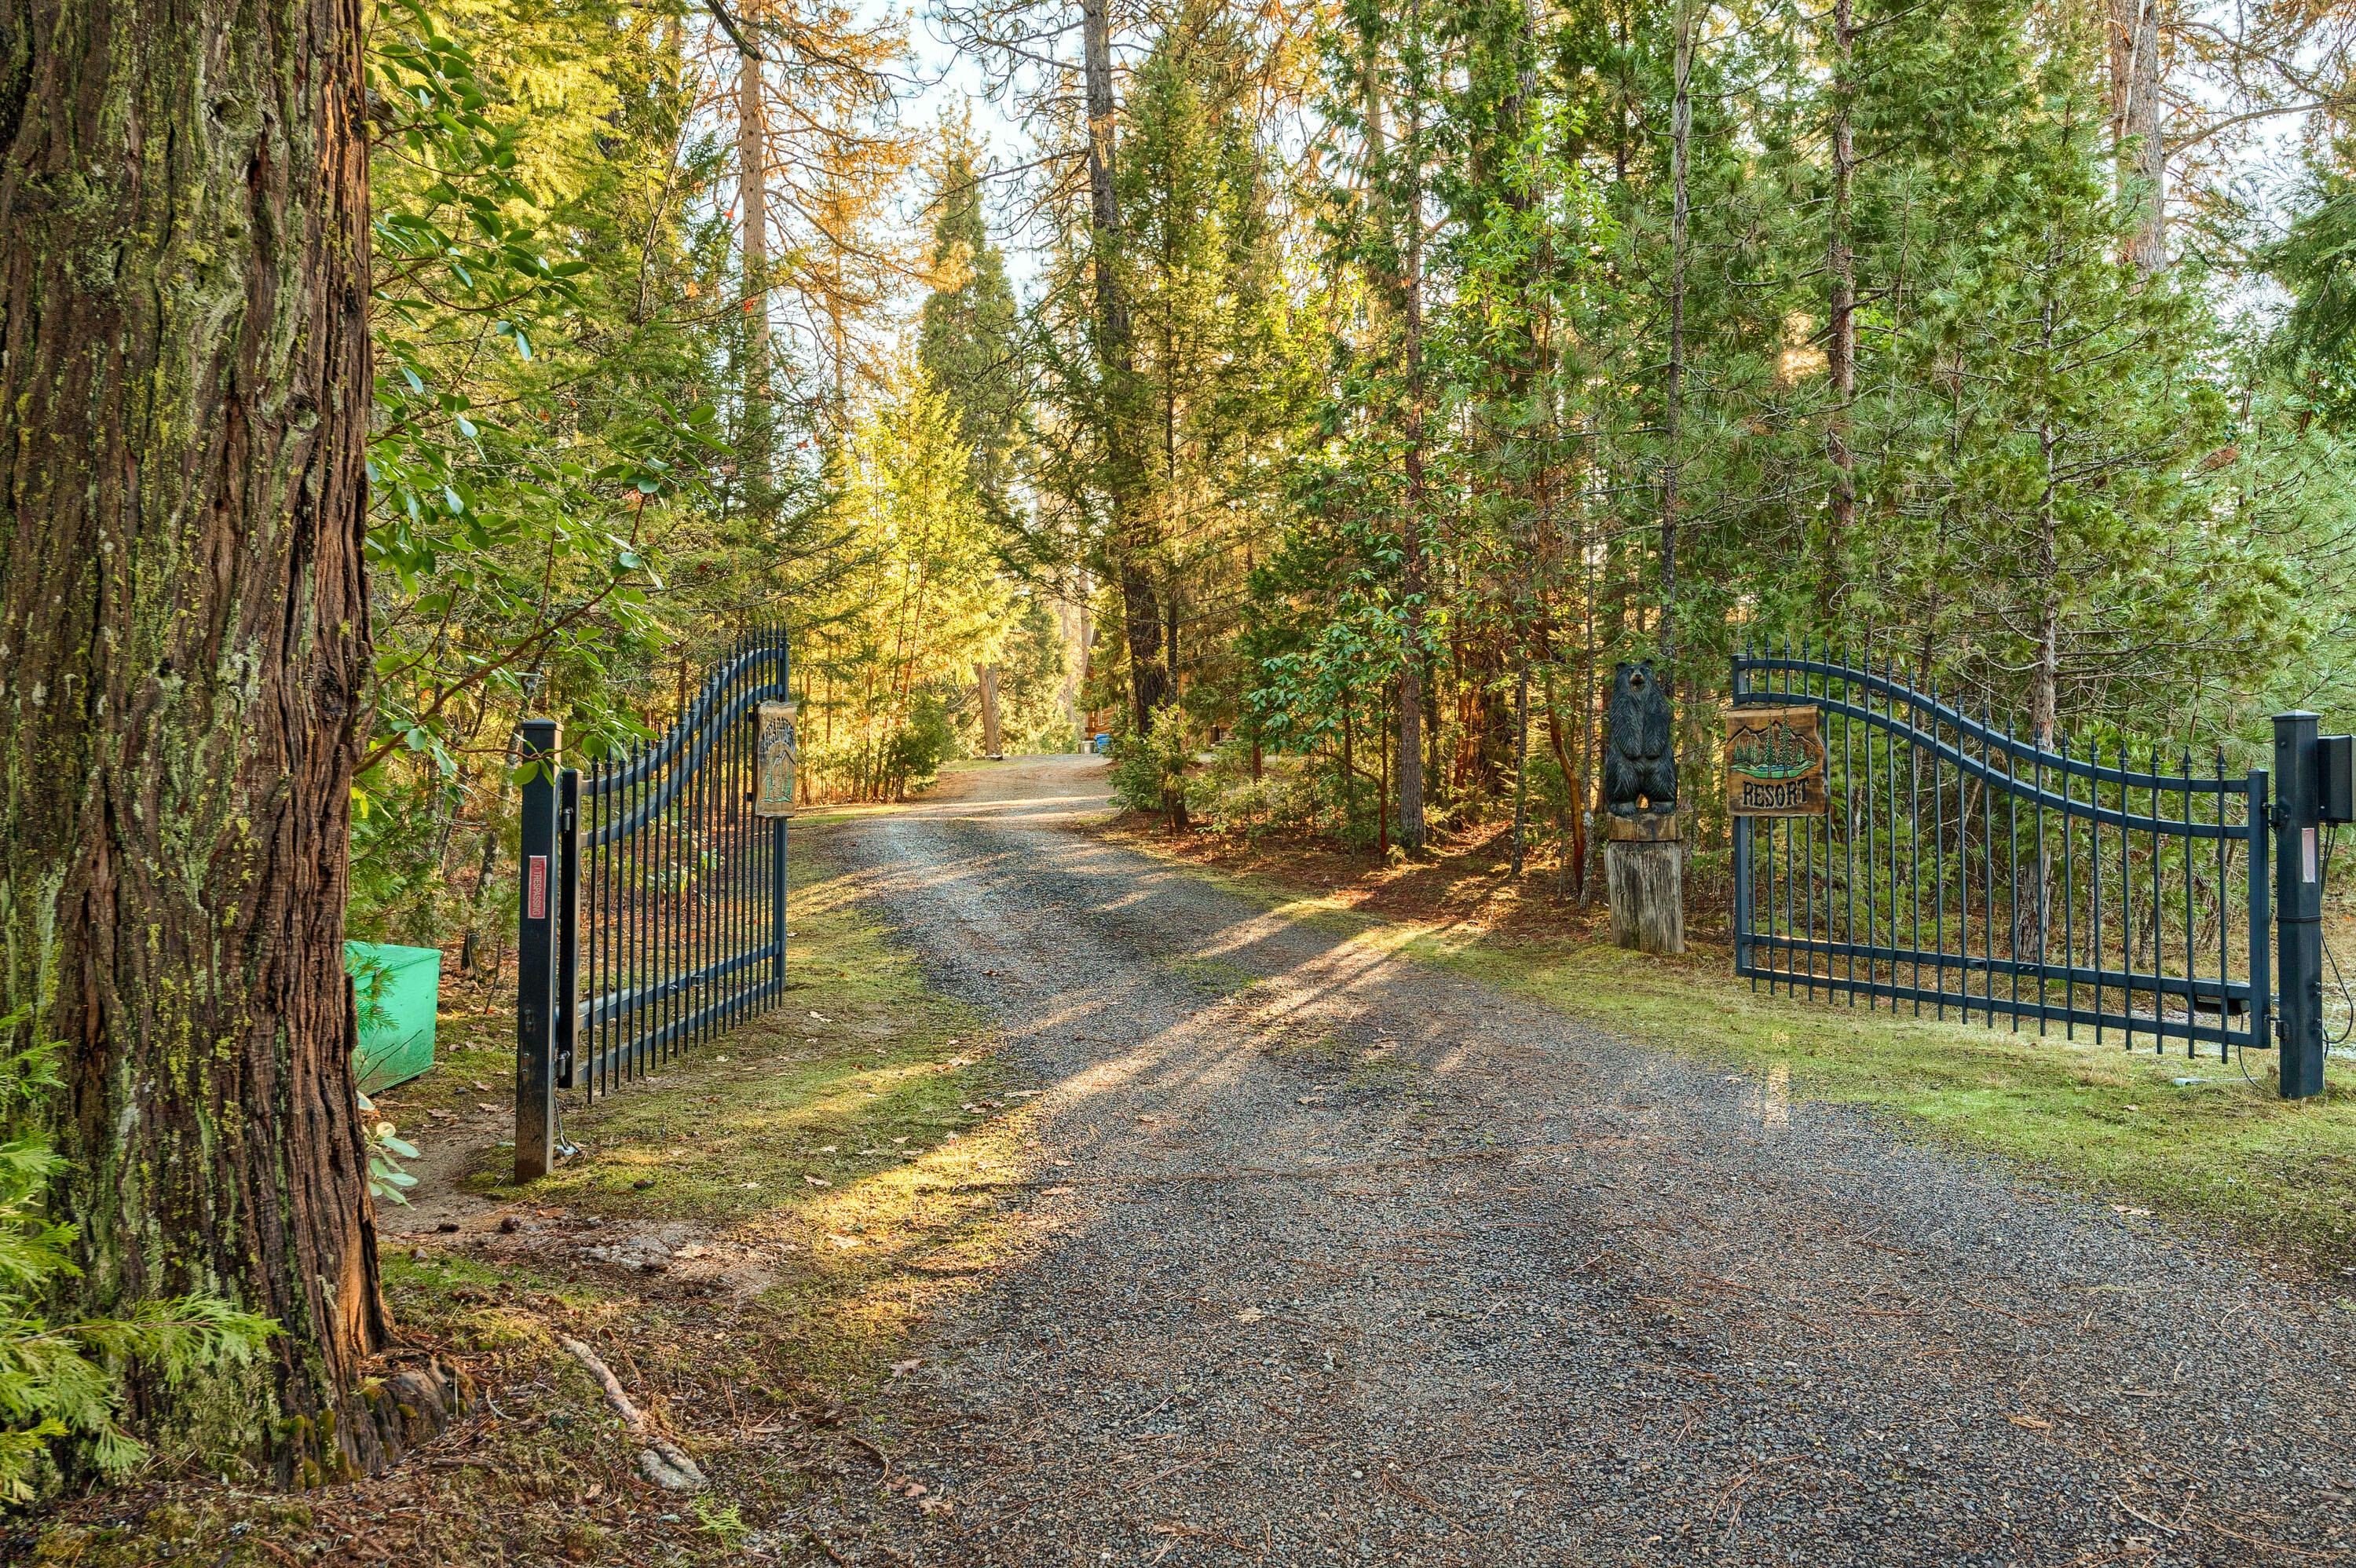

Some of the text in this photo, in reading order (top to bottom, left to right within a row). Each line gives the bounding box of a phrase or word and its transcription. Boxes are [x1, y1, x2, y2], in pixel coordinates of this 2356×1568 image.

[1743, 777, 1809, 808] RESORT
[532, 859, 543, 916] NO TRESPASSING
